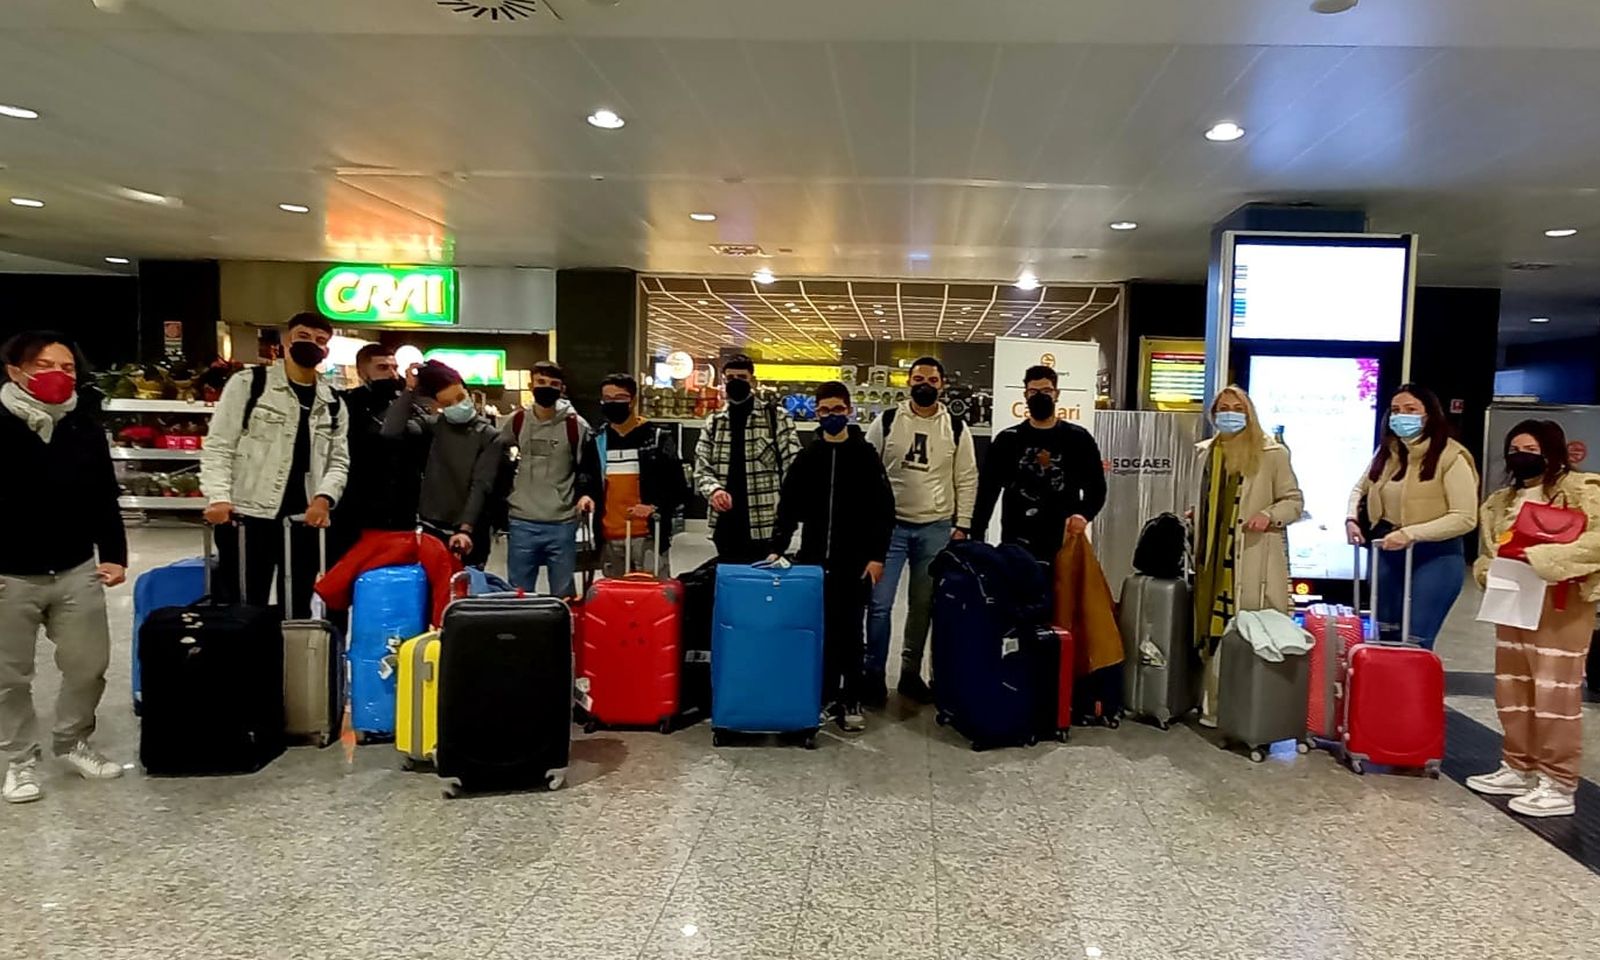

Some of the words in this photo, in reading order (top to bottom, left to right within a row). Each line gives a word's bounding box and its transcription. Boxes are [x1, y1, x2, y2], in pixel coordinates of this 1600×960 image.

[324, 273, 443, 314] CRAI
[1011, 401, 1081, 420] Caari
[904, 432, 929, 465] A
[1112, 457, 1172, 469] SOGAER
